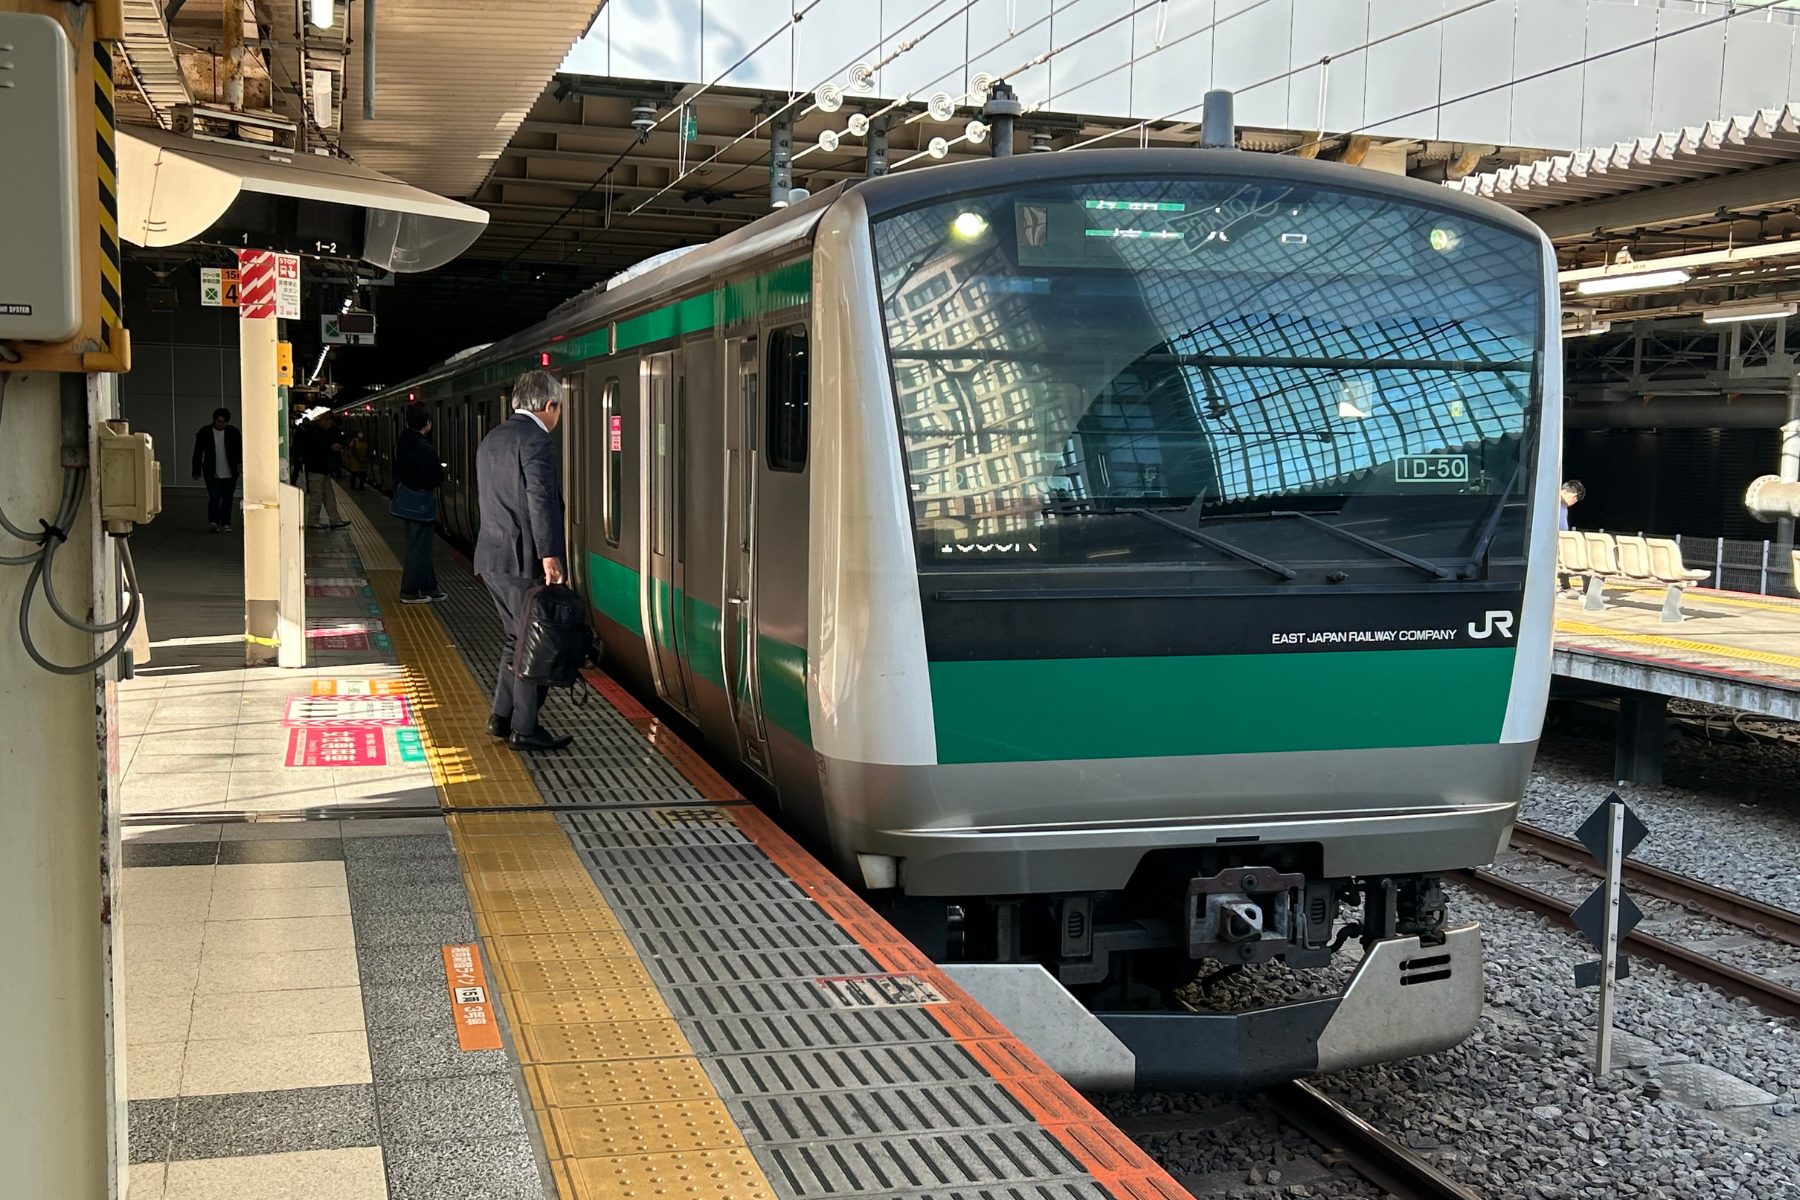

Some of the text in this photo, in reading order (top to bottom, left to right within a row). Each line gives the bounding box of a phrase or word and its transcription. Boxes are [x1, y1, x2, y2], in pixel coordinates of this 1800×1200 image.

[242, 233, 248, 244] 1
[315, 241, 337, 254] 1-2
[226, 284, 239, 303] 4
[1468, 610, 1514, 639] JR
[1271, 629, 1458, 645] EAST JAPAN RAILWAY COMPANY
[319, 730, 357, 762] 女性専用車
[464, 1006, 487, 1025] 3号車
